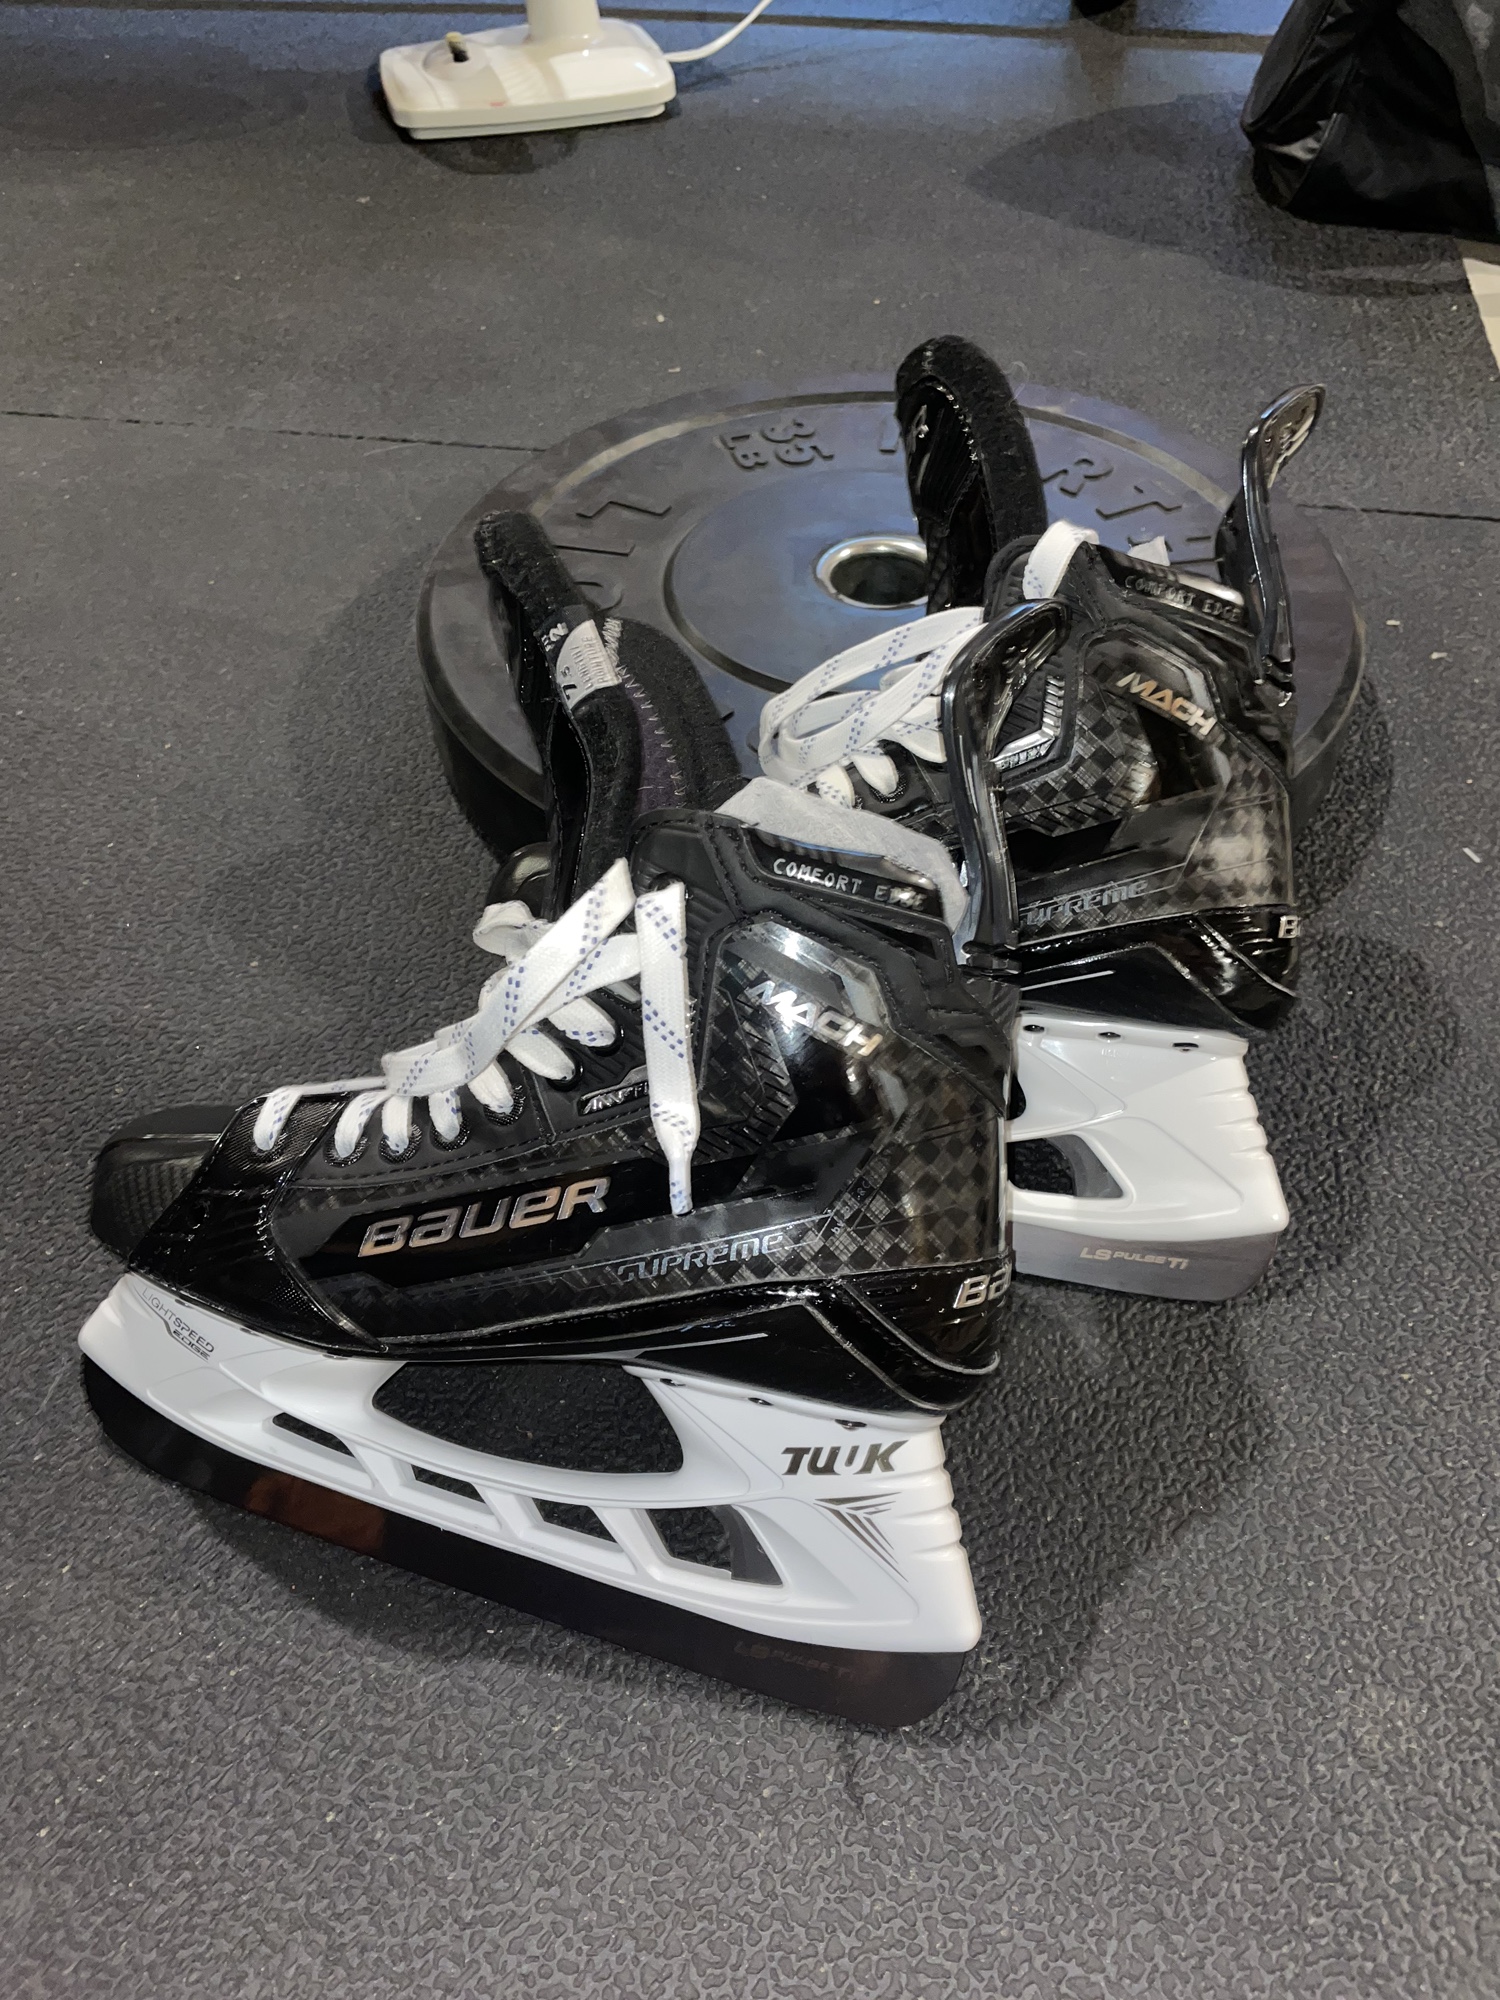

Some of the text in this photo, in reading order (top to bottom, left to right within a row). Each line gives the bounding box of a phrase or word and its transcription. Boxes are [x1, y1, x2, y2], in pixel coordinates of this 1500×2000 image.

[1115, 671, 1218, 736] MACH
[773, 858, 863, 894] COMFORT
[743, 980, 883, 1057] MACH
[357, 1176, 612, 1258] BAUER
[617, 1232, 784, 1284] SUPREME
[1080, 1247, 1112, 1261] LS
[1112, 1250, 1167, 1265] PULSE
[142, 1287, 215, 1353] LIGHTSPEED
[172, 1328, 211, 1361] EDGE
